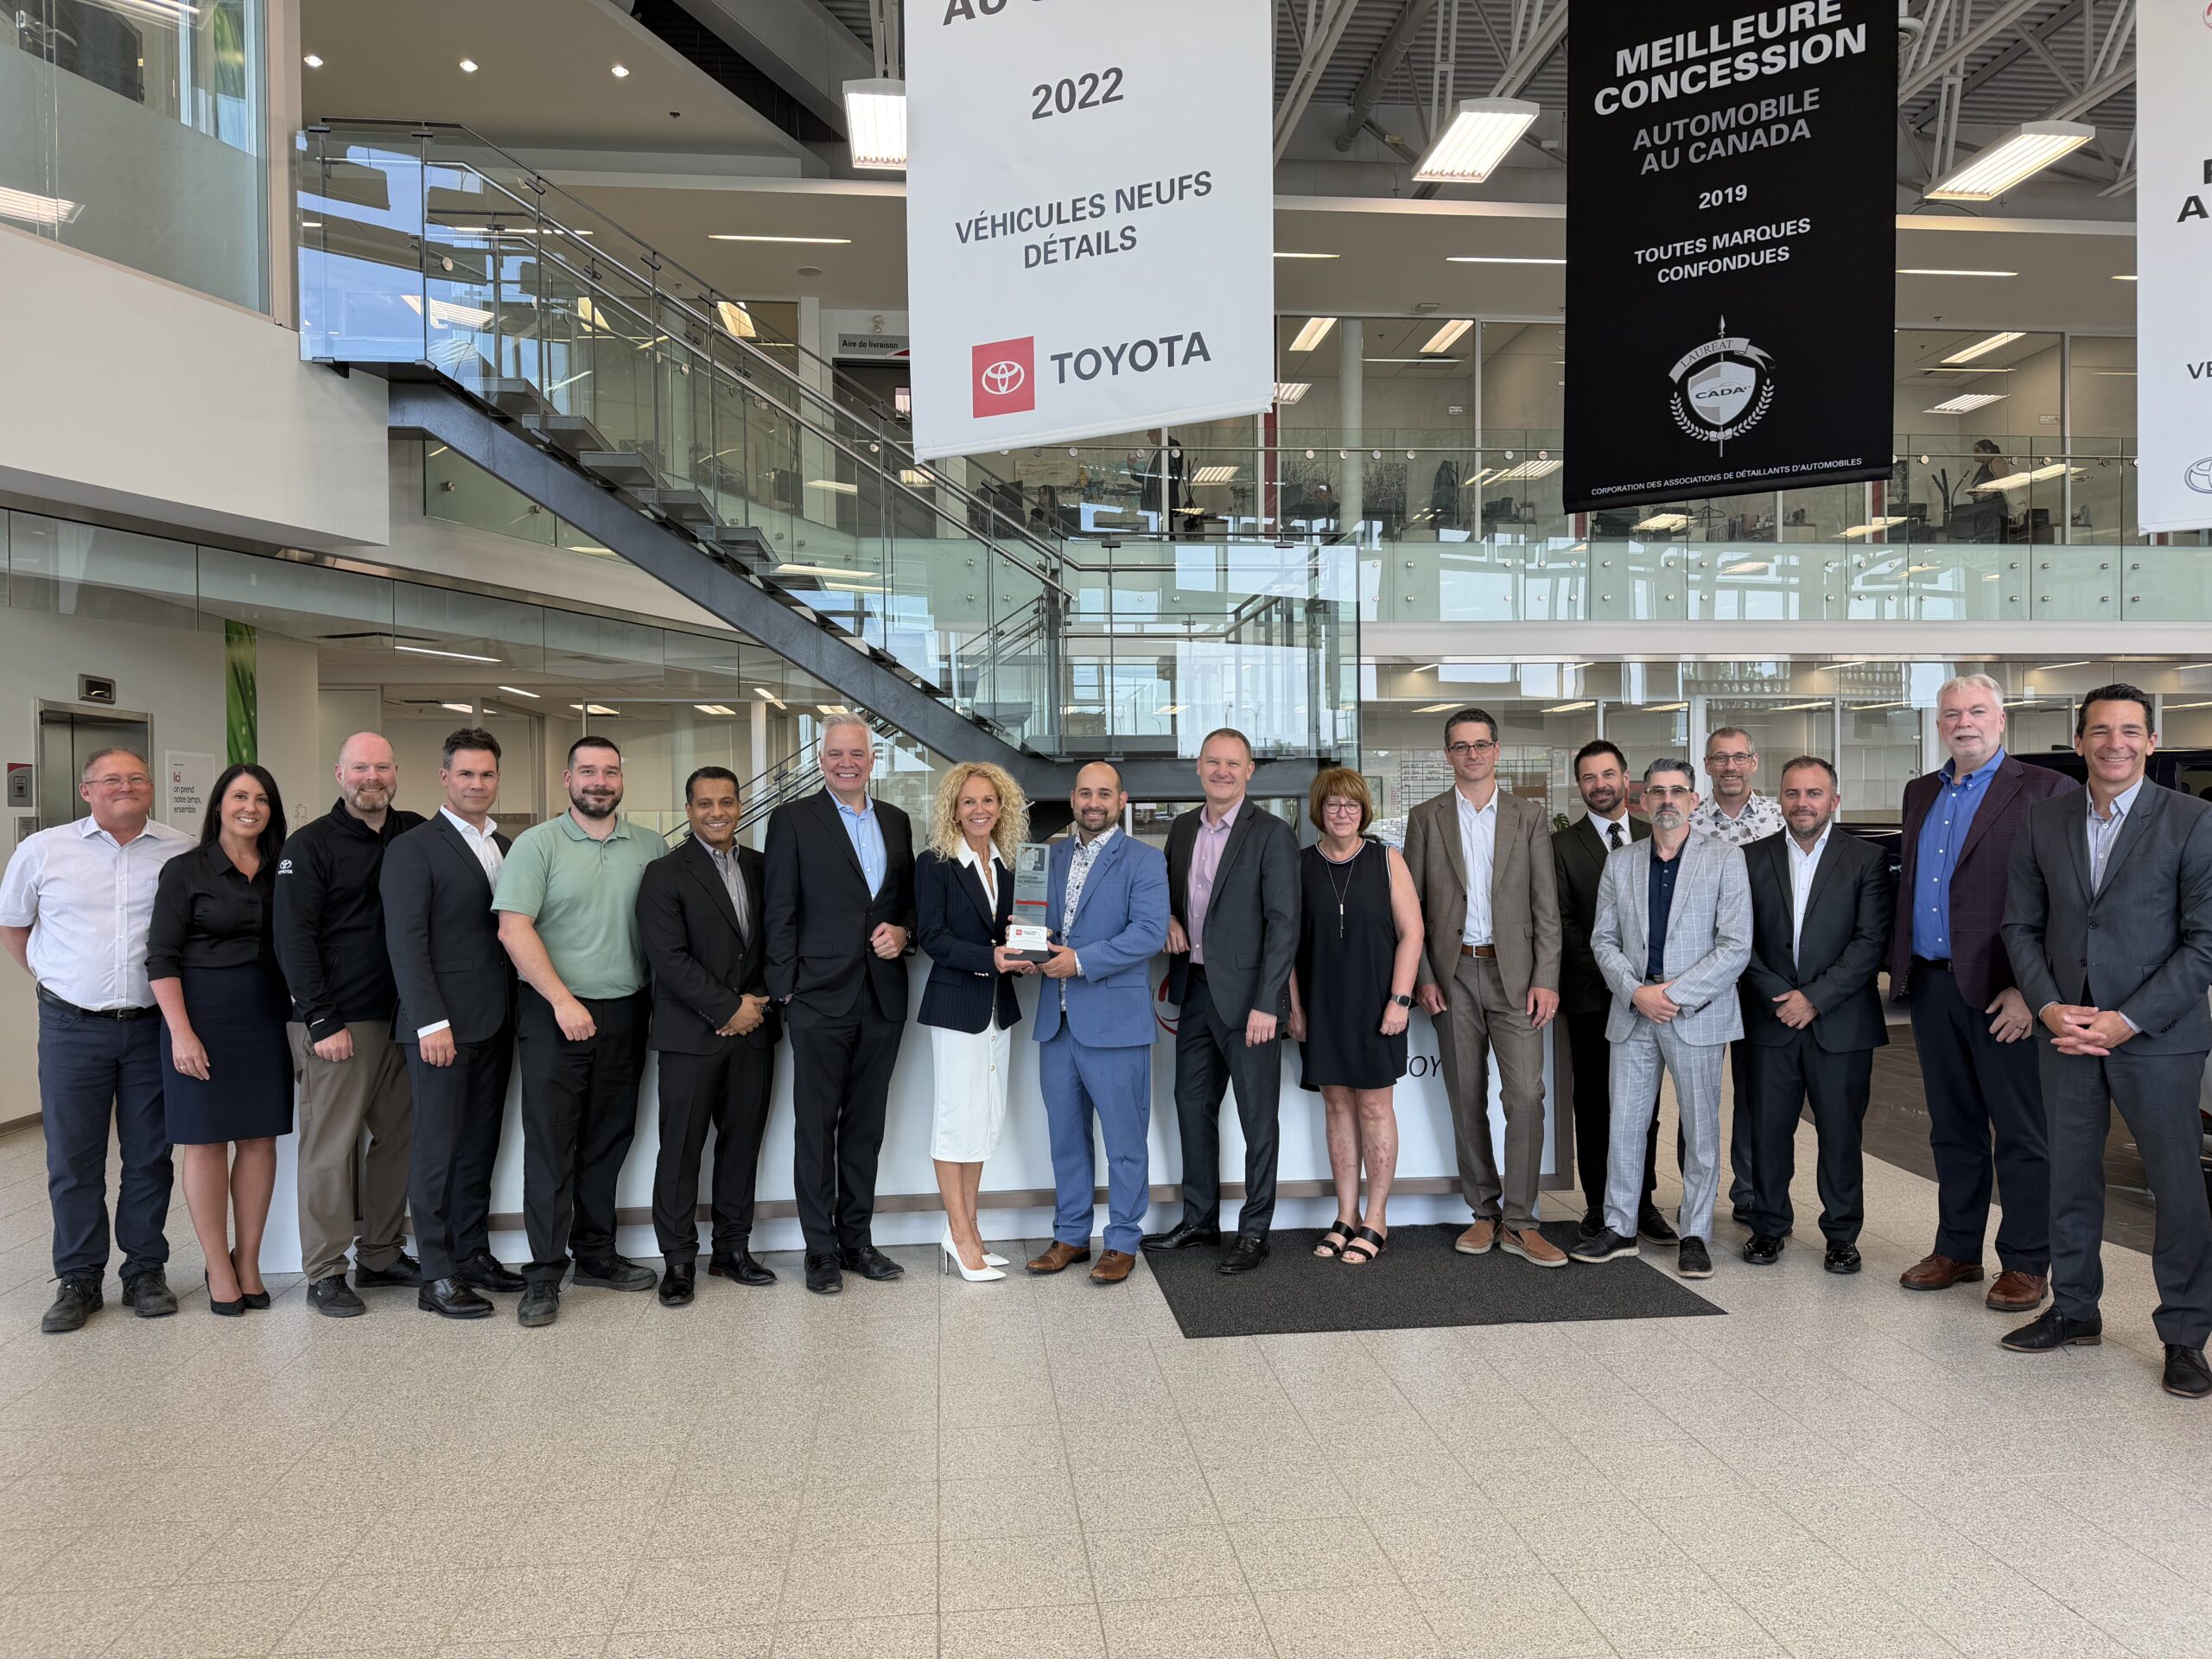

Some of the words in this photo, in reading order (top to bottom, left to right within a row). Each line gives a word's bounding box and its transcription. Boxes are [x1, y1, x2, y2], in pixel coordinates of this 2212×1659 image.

[1616, 0, 1842, 77] MEILLEURE
[1594, 22, 1866, 116] CONCESSION
[1031, 67, 1124, 120] 2022
[1632, 87, 1820, 151] AUTOMOBILE
[1640, 147, 1680, 175] AU
[1688, 118, 1811, 164] CANADA
[955, 192, 1106, 245] VÉHICULES
[1115, 170, 1212, 214] NEUFS
[1699, 184, 1748, 210] 2019
[1024, 225, 1137, 270] DÉTAILS
[1634, 238, 1707, 264] TOUTES
[1713, 218, 1811, 251] MARQUES
[1657, 245, 1790, 283] CONFONDUES
[858, 340, 868, 348] de
[868, 340, 899, 349] livraison
[1050, 331, 1211, 385] TOYOTA
[1680, 340, 1734, 368] LAURÉAT
[1695, 386, 1745, 399] CADA
[1591, 483, 1645, 496] CORPORATION
[1646, 480, 1662, 489] DES
[1663, 474, 1722, 486] ASSOCIATIONS
[1736, 465, 1790, 479] DÉTAILLANTS
[1792, 458, 1862, 472] D'AUTOMOBILES
[181, 785, 194, 794] prend
